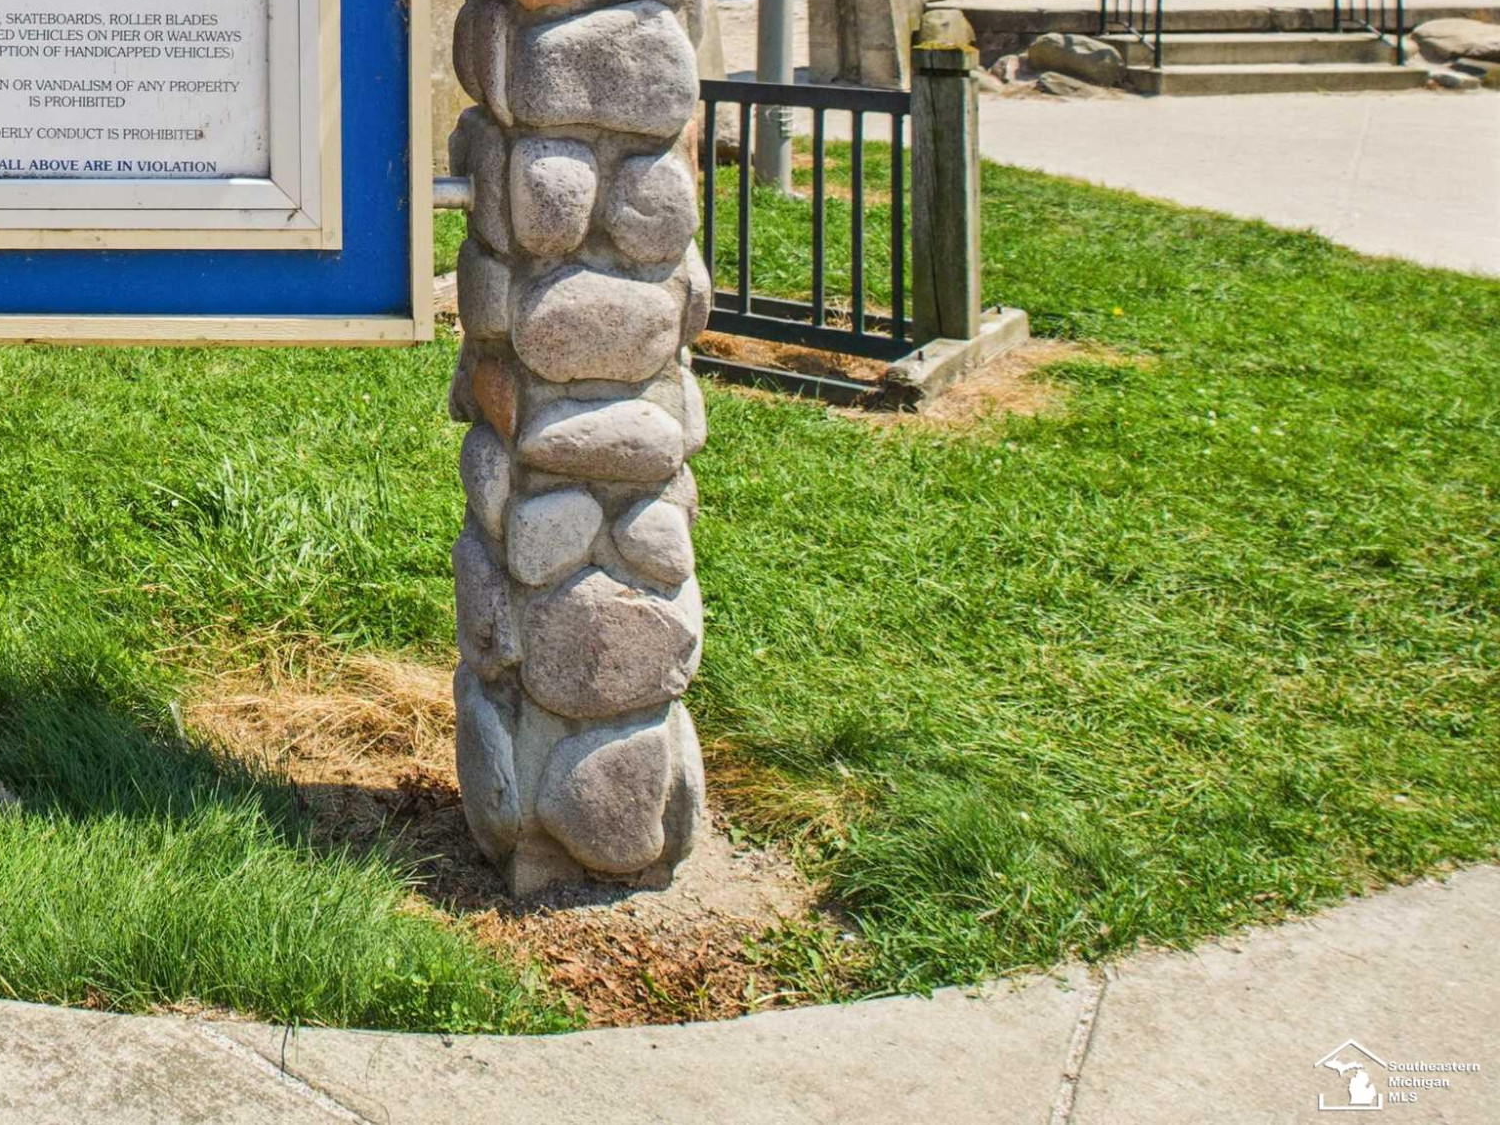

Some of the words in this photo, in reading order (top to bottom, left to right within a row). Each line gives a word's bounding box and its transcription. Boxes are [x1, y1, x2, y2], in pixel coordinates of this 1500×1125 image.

[6, 13, 105, 26] SKATEBOARDS,
[110, 14, 161, 25] ROLLER
[166, 14, 218, 25] BLADES
[18, 30, 83, 40] VEHICLES
[87, 30, 107, 41] ON
[112, 30, 140, 41] PIER
[144, 30, 163, 41] OR
[167, 31, 242, 42] WALKWAYS
[43, 46, 61, 57] OF
[65, 47, 161, 57] HANDICAPPED
[164, 47, 234, 58] VEHICLES)
[13, 79, 32, 91] OR
[36, 80, 112, 91] VANDALISM
[116, 80, 134, 92] OF
[138, 81, 165, 91] ANY
[170, 81, 239, 92] PROPERTY
[29, 96, 40, 107] IS
[45, 96, 125, 107] PROHIBITED
[37, 128, 104, 139] CONDUCT
[108, 128, 119, 140] IS
[123, 129, 205, 140] PROHIBITED
[28, 159, 79, 172] ABOVE
[83, 160, 113, 172] ARE
[117, 160, 133, 172] IN
[137, 160, 218, 173] VIOLATION
